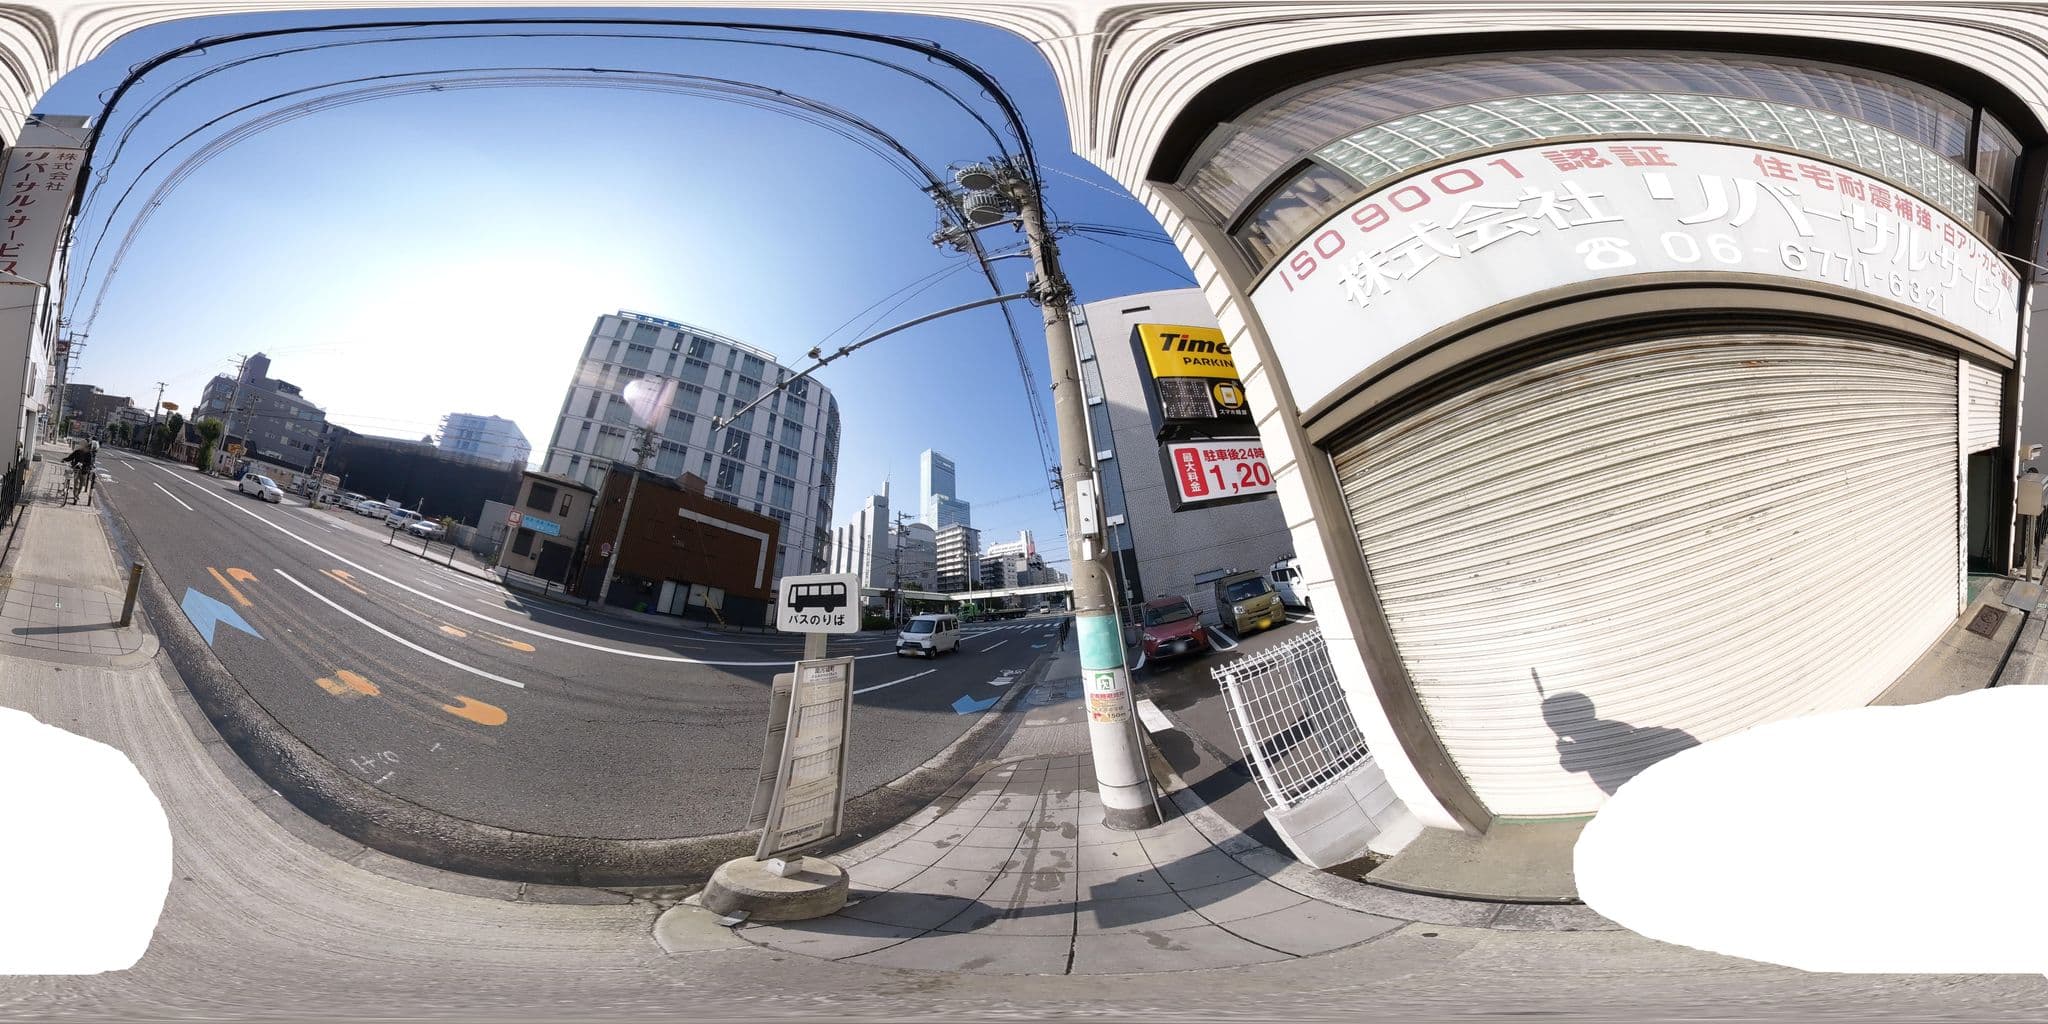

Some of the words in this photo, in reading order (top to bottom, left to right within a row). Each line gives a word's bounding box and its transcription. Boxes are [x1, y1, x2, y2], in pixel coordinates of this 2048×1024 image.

[45, 152, 78, 192] 株式会社
[1182, 452, 1202, 493] 最大料金
[789, 614, 845, 626] バスのりば
